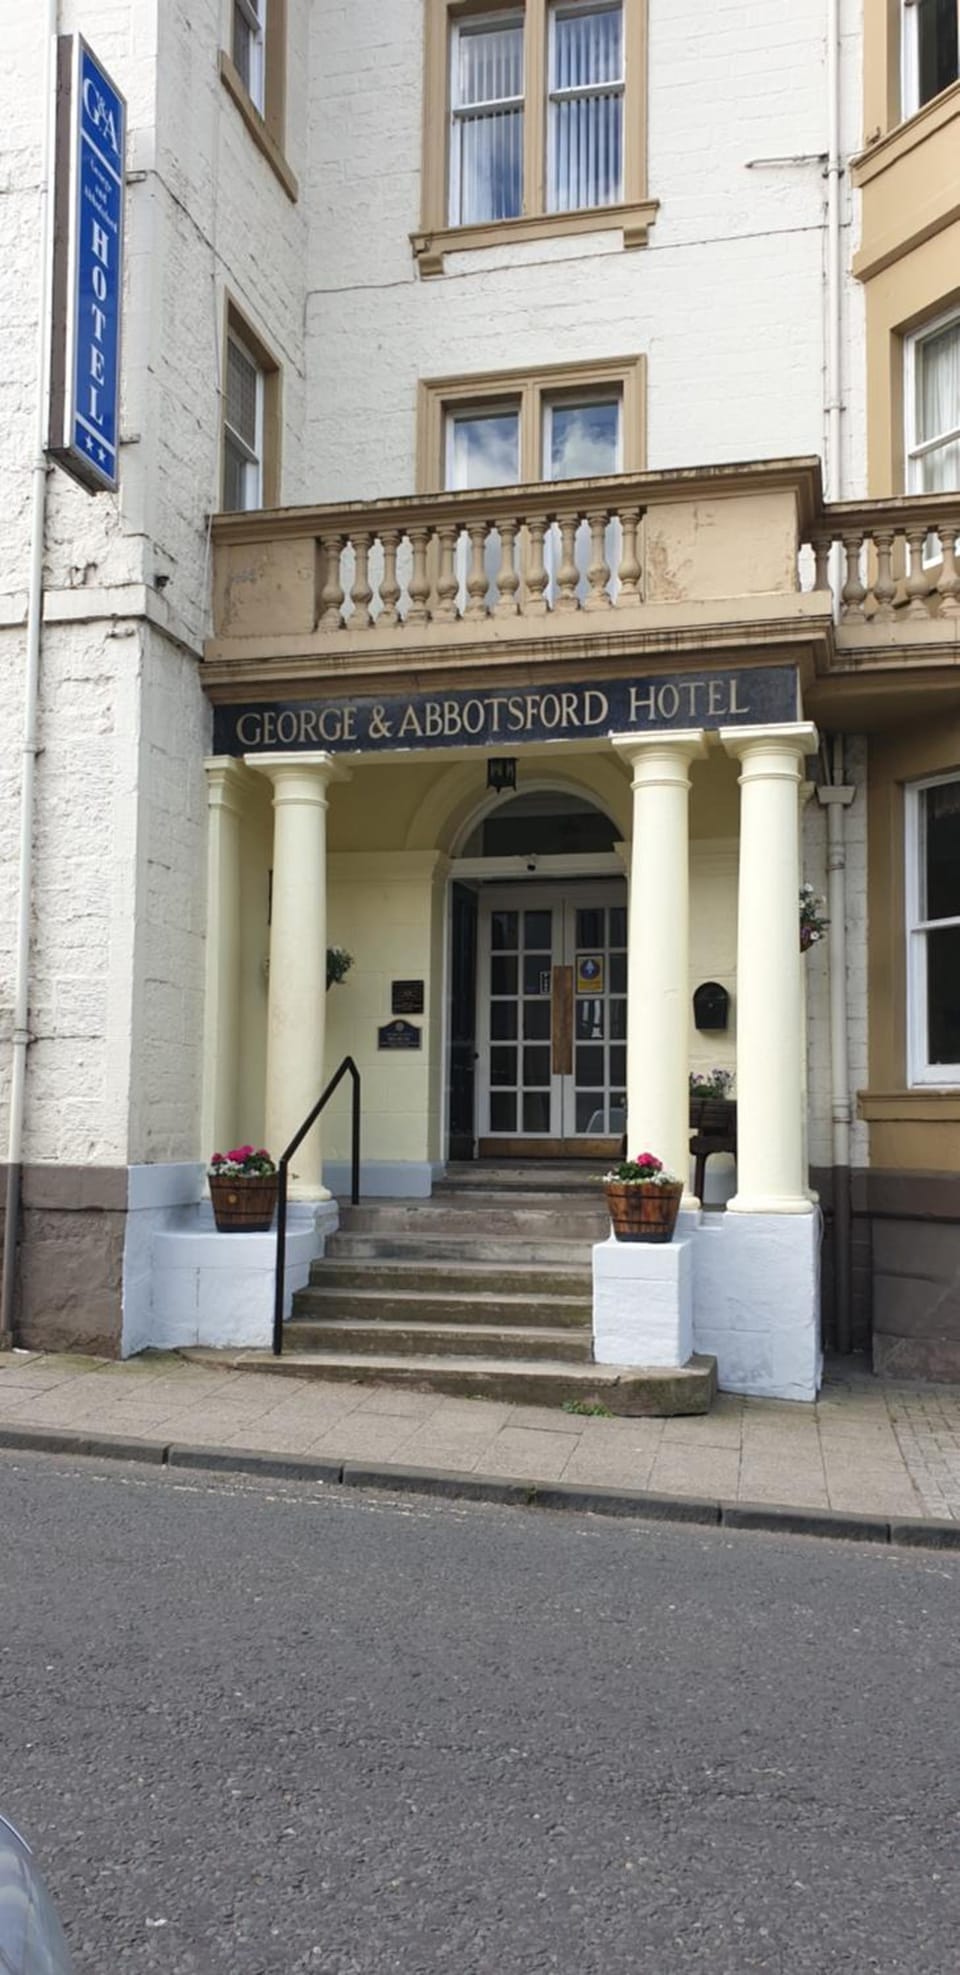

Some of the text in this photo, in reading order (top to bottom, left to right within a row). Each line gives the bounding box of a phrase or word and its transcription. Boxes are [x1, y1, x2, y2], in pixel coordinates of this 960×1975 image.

[84, 78, 120, 158] G&A
[90, 218, 110, 426] HOTEL
[236, 679, 749, 745] GEORGE & ABBOTSFORD HOTEL
